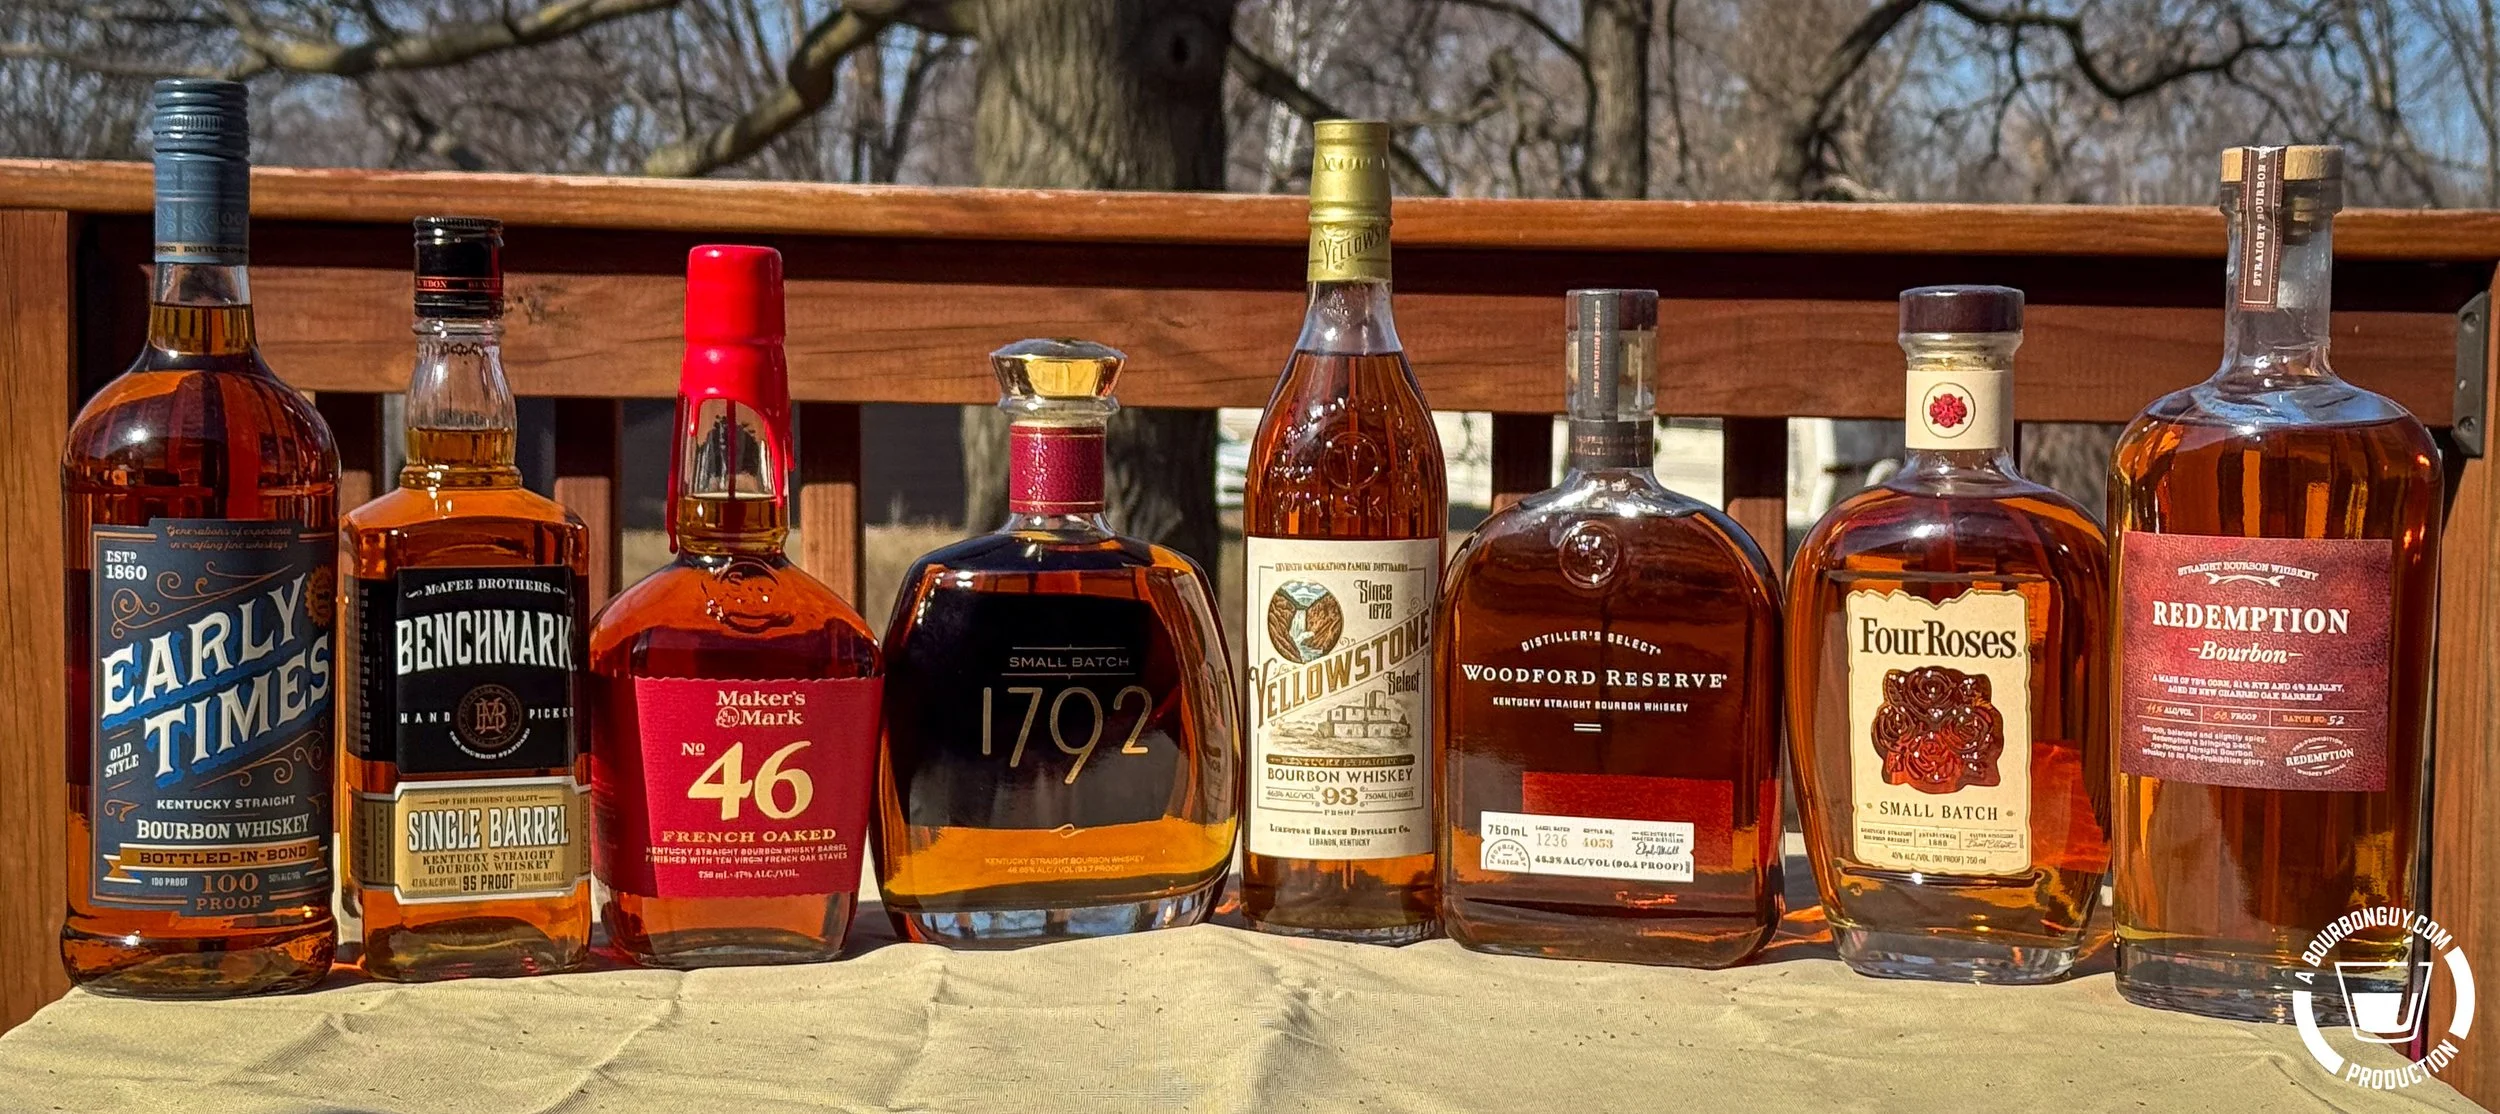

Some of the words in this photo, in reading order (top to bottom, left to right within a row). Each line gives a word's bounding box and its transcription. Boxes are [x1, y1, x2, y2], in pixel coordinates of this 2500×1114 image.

[2255, 164, 2266, 220] BOURBON
[2253, 224, 2266, 287] STRAIGHT
[106, 565, 147, 580] 1860
[1303, 563, 1346, 571] GENERATION
[2177, 561, 2223, 577] STRAIGHT
[2223, 561, 2269, 573] BOURBON
[2271, 564, 2319, 581] WHISKEY
[478, 578, 551, 593] BROTHERS
[1354, 580, 1392, 604] Since
[1369, 603, 1392, 619] 1872
[2153, 601, 2351, 634] REDEMPTION
[102, 572, 306, 719] EARLY
[395, 610, 574, 676] BENCHMARK
[1521, 630, 1600, 652] DISTILLER'S
[1607, 633, 1656, 655] SELECT
[1860, 617, 1925, 656] Four
[1922, 619, 2017, 659] Roses
[2198, 641, 2288, 664] Bourbon
[1009, 656, 1067, 667] SMALL
[1072, 657, 1130, 667] BATCH
[1249, 608, 1430, 728] YELLOWSTONE
[1382, 667, 1421, 695] Select
[1462, 664, 1596, 684] WOODFORD
[1606, 670, 1722, 689] RESERVE
[144, 632, 330, 779] TIMES
[716, 690, 806, 706] Maker's
[1492, 697, 1541, 707] KENTUCKY
[1544, 699, 1591, 709] STRAIGHT
[1595, 700, 1641, 711] BOURBON
[1644, 702, 1688, 713] WHISKEY
[401, 712, 451, 724] HAND
[740, 709, 804, 726] Mark
[2283, 715, 2311, 723] BATCH
[2327, 716, 2345, 724] 52
[982, 686, 1152, 784] 1792
[109, 741, 132, 761] OLD
[2285, 748, 2354, 767] REDEMPTION
[105, 754, 140, 778] STYLE
[1281, 756, 1339, 766] KENTUCKY
[1343, 757, 1399, 766] STRAIGHT
[687, 740, 814, 821] 46
[1267, 768, 1339, 783] BOURBON
[1347, 768, 1413, 782] WHISKEY
[157, 799, 231, 810] KENTUCKY
[235, 795, 296, 808] STRAIGHT
[452, 797, 467, 805] THE
[469, 796, 504, 805] HIGHEST
[506, 795, 538, 803] QUALITY
[1322, 787, 1359, 805] 93
[1880, 801, 1934, 818] SMALL
[1941, 805, 1998, 821] BATCH
[136, 819, 231, 840] BOURBON
[236, 813, 310, 838] WHISKEY
[408, 809, 482, 852] SINGLE
[489, 806, 570, 848] BARREL
[1488, 825, 1528, 837] 750mL
[662, 831, 755, 843] FRENCH
[762, 828, 837, 841] OAKED
[1339, 838, 1371, 846] KENTUCKY
[1536, 833, 1568, 848] 1236
[140, 846, 307, 864] BOTTLED-IN-BOND
[423, 852, 488, 865] KENTUCKY
[493, 850, 555, 861] STRAIGHT
[646, 846, 692, 855] KENTUCKY
[818, 845, 848, 853] BARREL
[690, 856, 712, 864] WITH
[818, 853, 847, 861] STAVES
[428, 863, 488, 875] BOURBON
[495, 860, 550, 871] WHISKEY
[1030, 857, 1069, 865] STRAIGHT
[1111, 855, 1145, 863] WHISKEY
[1563, 857, 1610, 867] ALC/VOL
[1640, 862, 1684, 871] PROOF)
[166, 877, 188, 887] PROOF
[202, 873, 259, 894] 100
[463, 875, 476, 890] 95
[481, 873, 515, 890] PROOF
[521, 873, 532, 881] 750
[196, 895, 263, 911] PROOF
